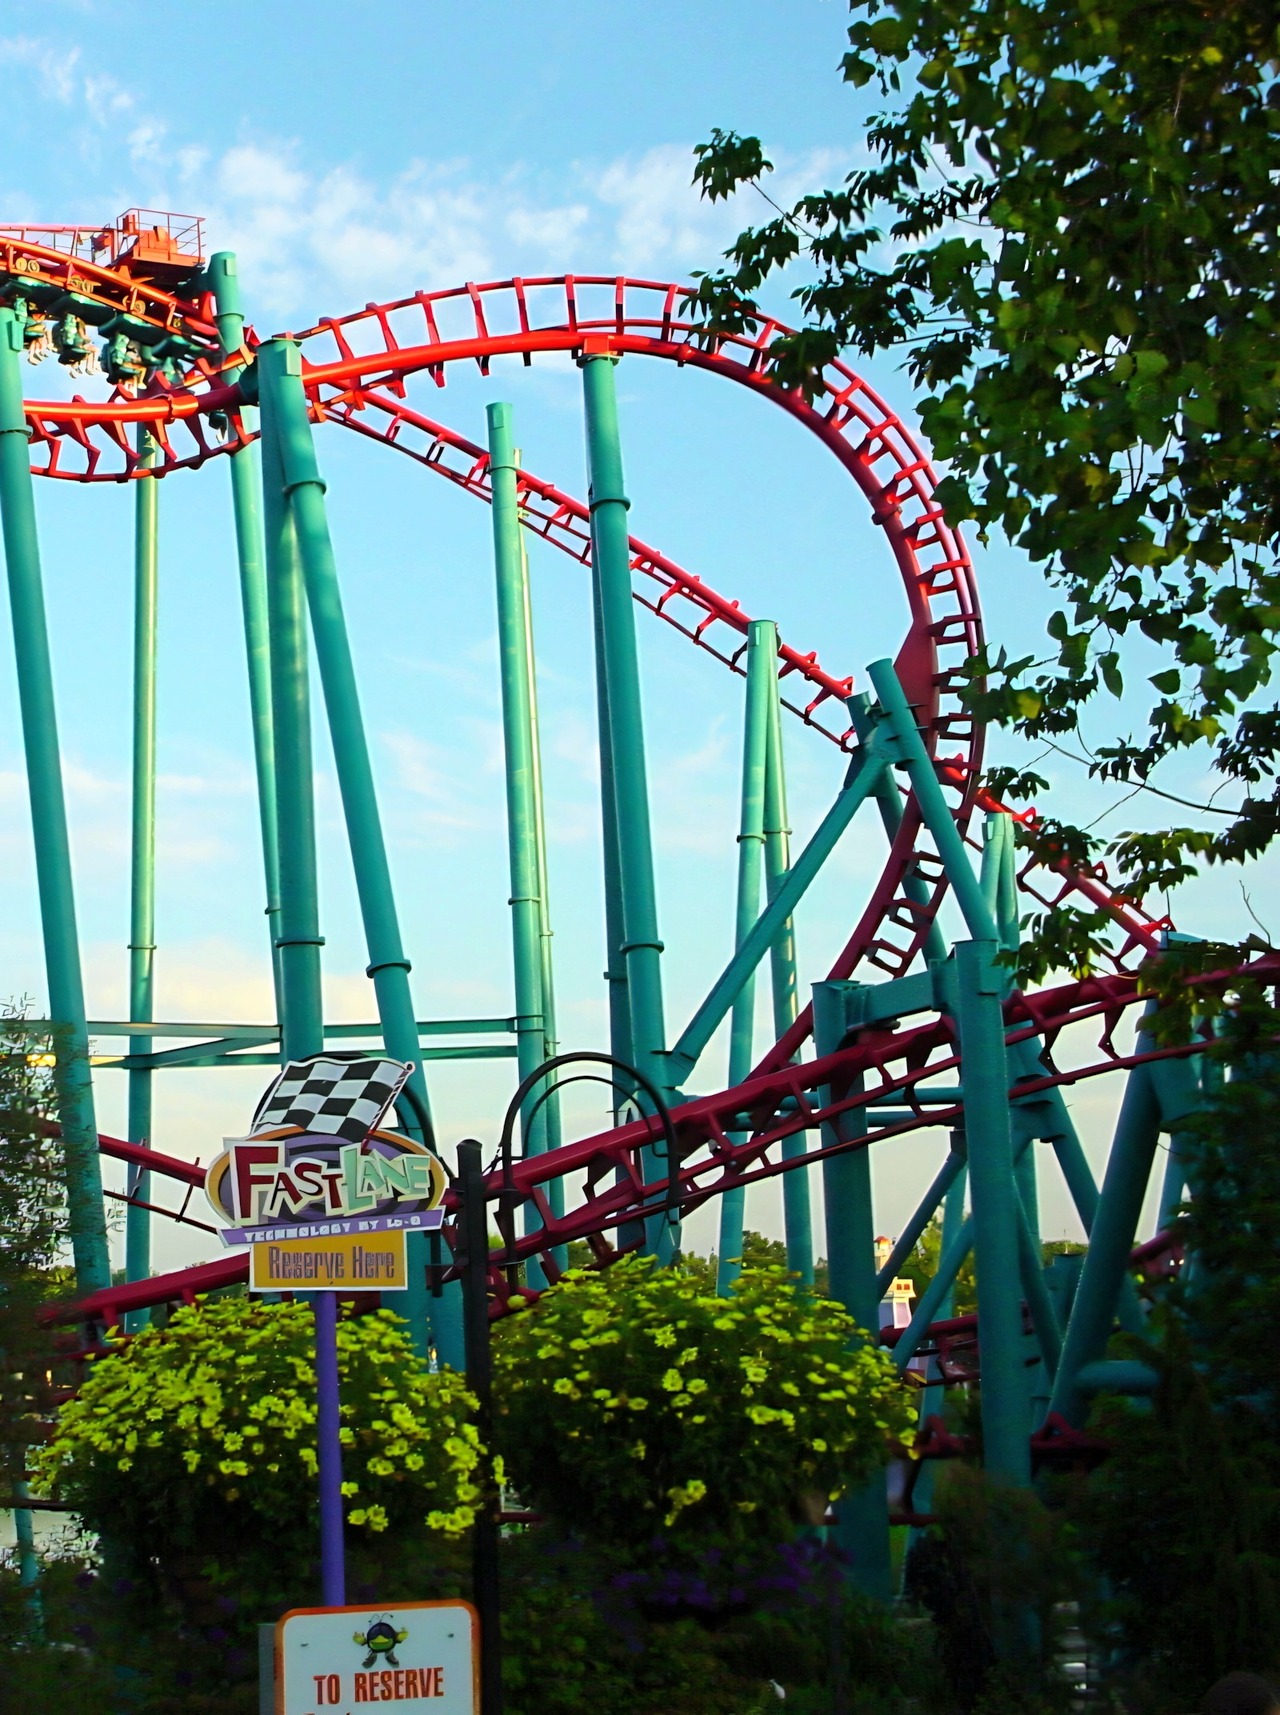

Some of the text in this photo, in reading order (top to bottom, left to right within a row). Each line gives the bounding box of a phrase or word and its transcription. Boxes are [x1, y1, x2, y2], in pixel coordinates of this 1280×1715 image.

[234, 1145, 431, 1218] FAST LANE
[269, 1246, 395, 1279] Reserve Here
[313, 1667, 444, 1706] TO RESERVE
